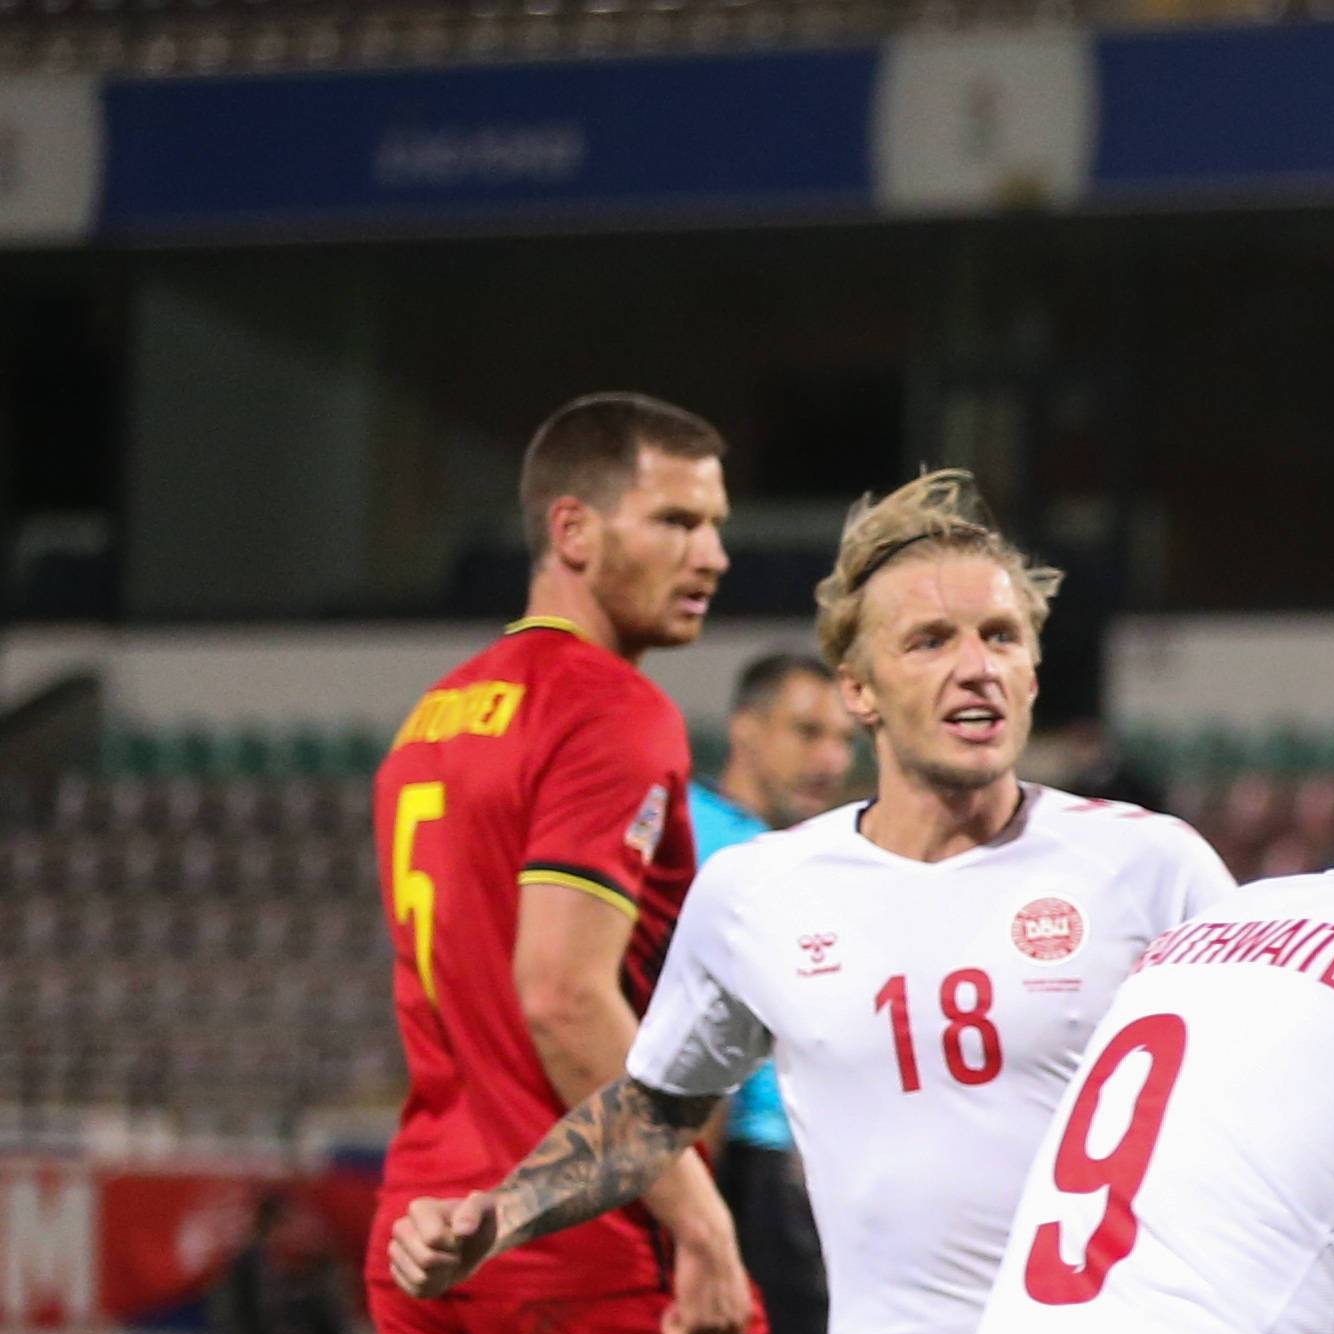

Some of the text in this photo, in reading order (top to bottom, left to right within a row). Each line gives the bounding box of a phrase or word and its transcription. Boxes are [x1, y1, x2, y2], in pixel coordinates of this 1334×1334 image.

[392, 780, 446, 1009] 5
[874, 967, 1003, 1092] 18
[1025, 1013, 1188, 1306] 9
